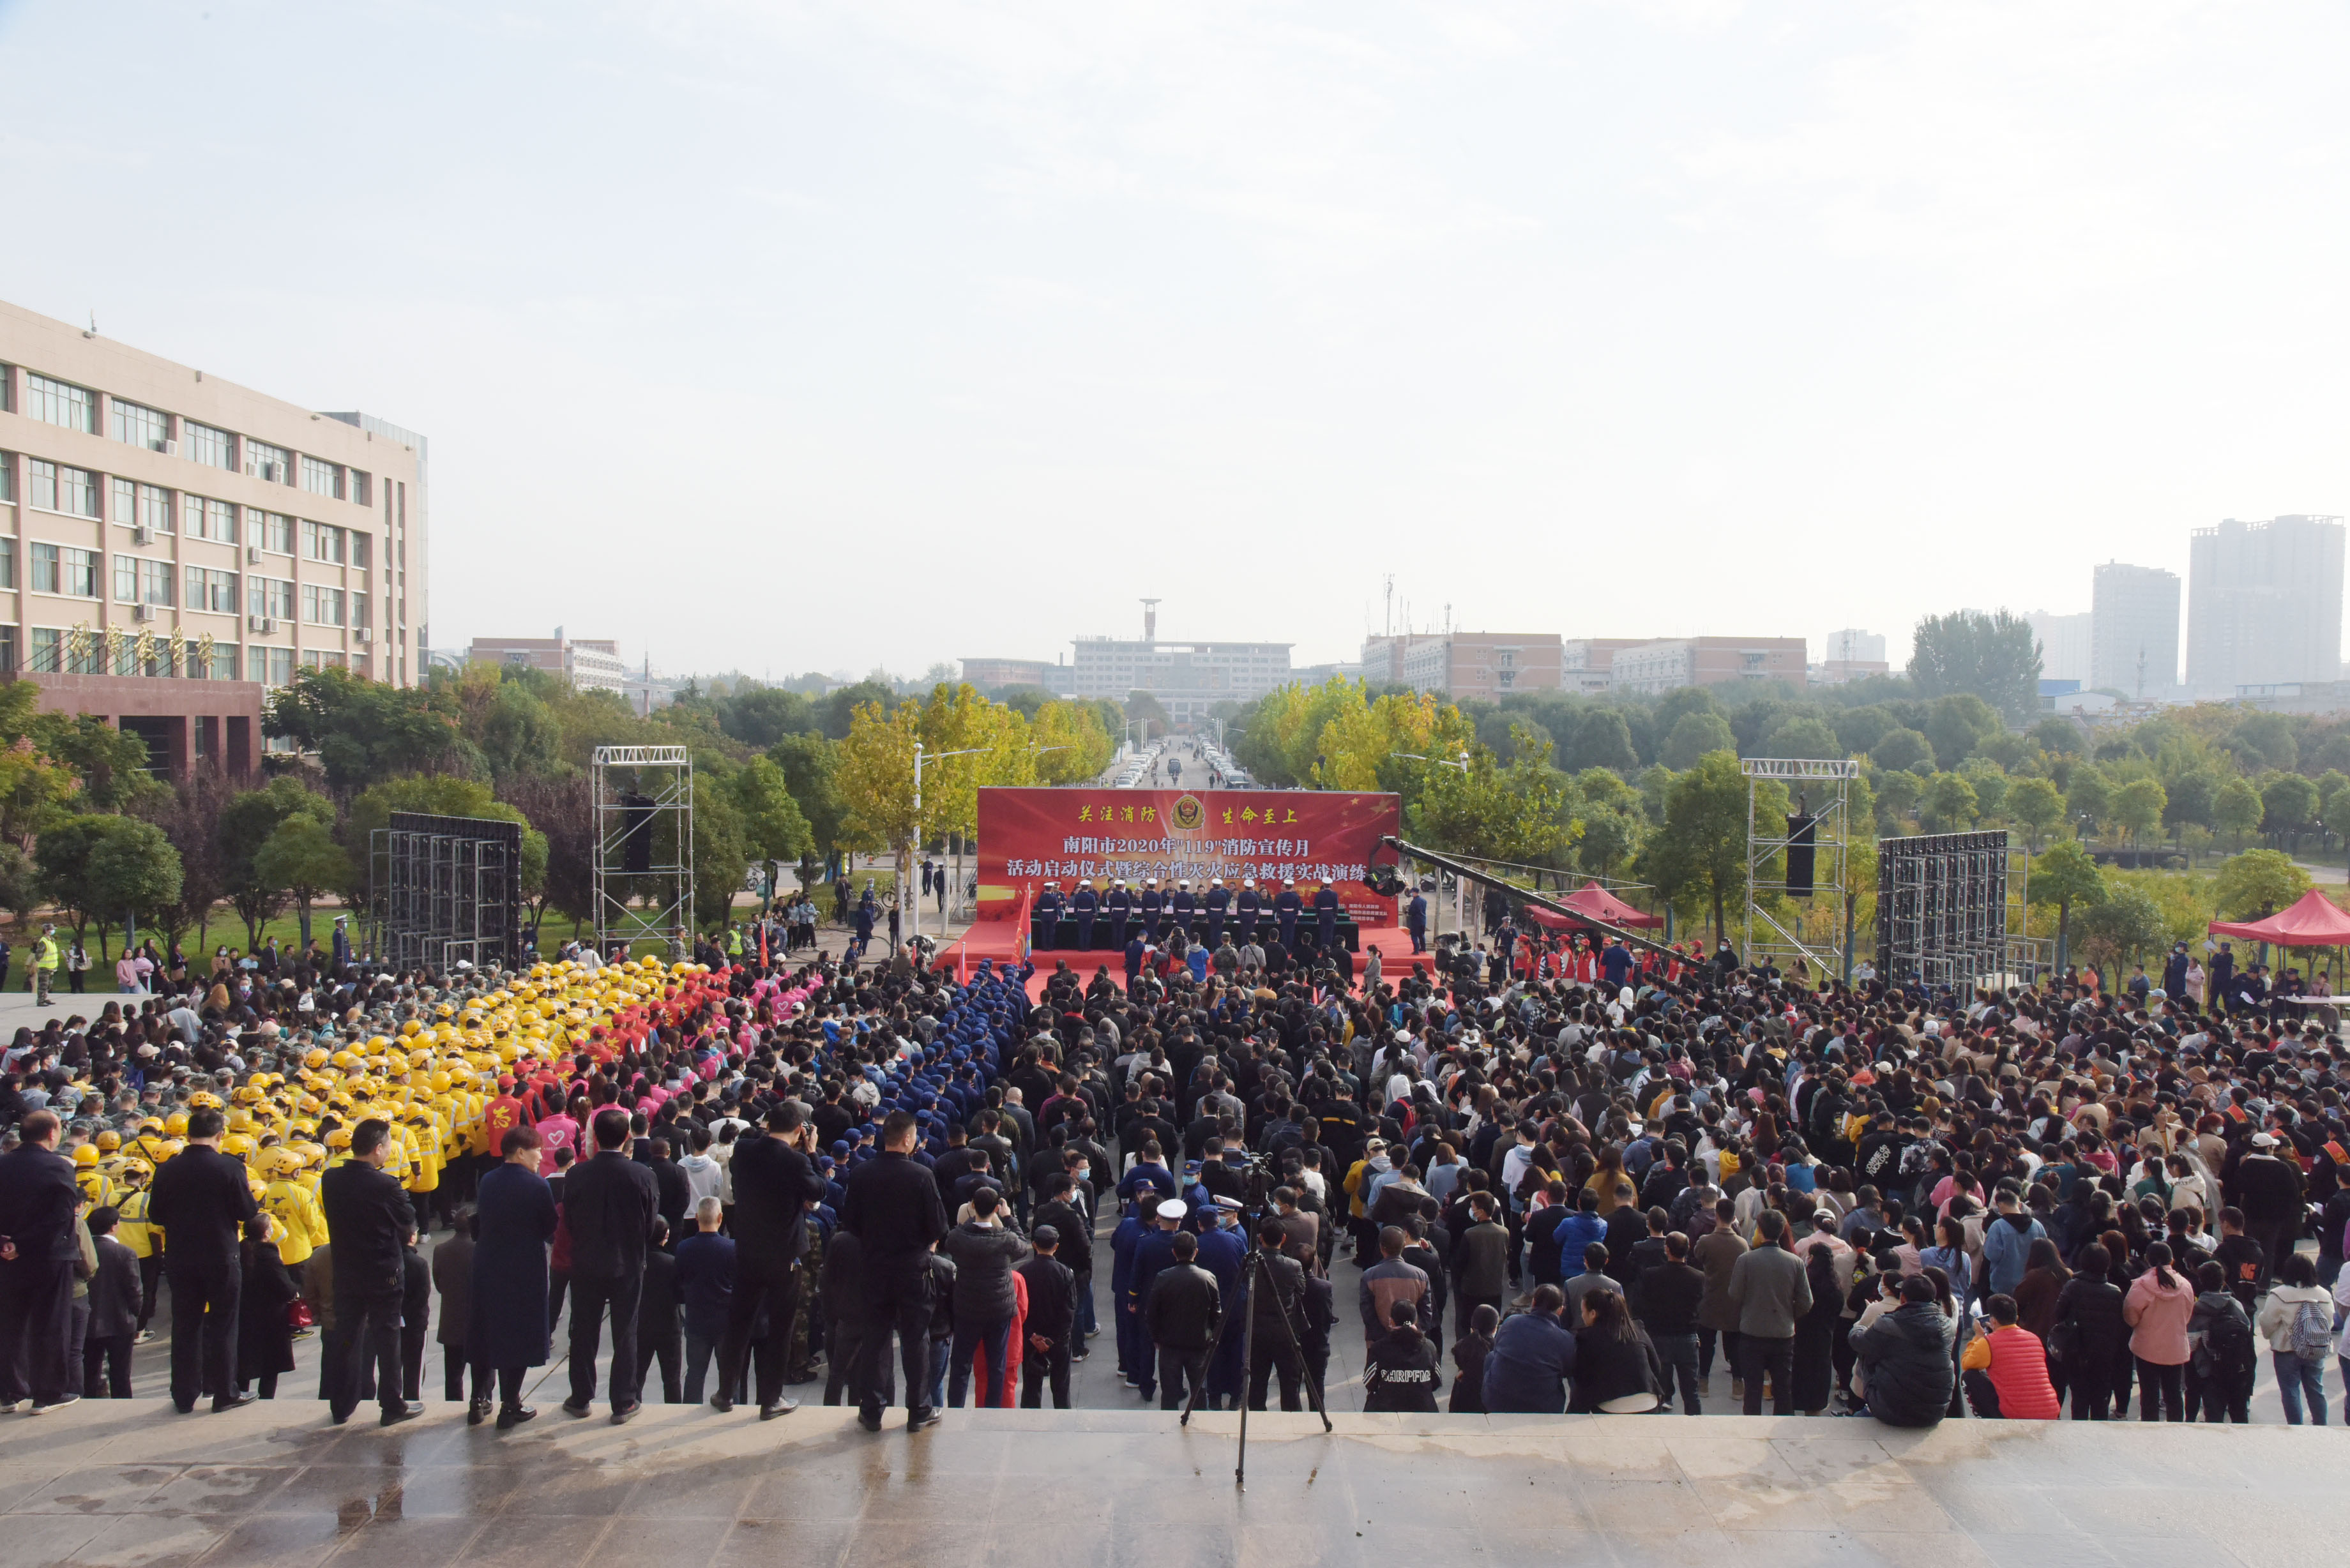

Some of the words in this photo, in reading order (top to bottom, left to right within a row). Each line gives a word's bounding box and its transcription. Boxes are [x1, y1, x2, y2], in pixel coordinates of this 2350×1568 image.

[1078, 804, 1156, 823] 关注消防
[1222, 806, 1298, 825] 生命至上
[1006, 859, 1367, 882] 活动启动仪式暨综合性灭火应急救援实战演练
